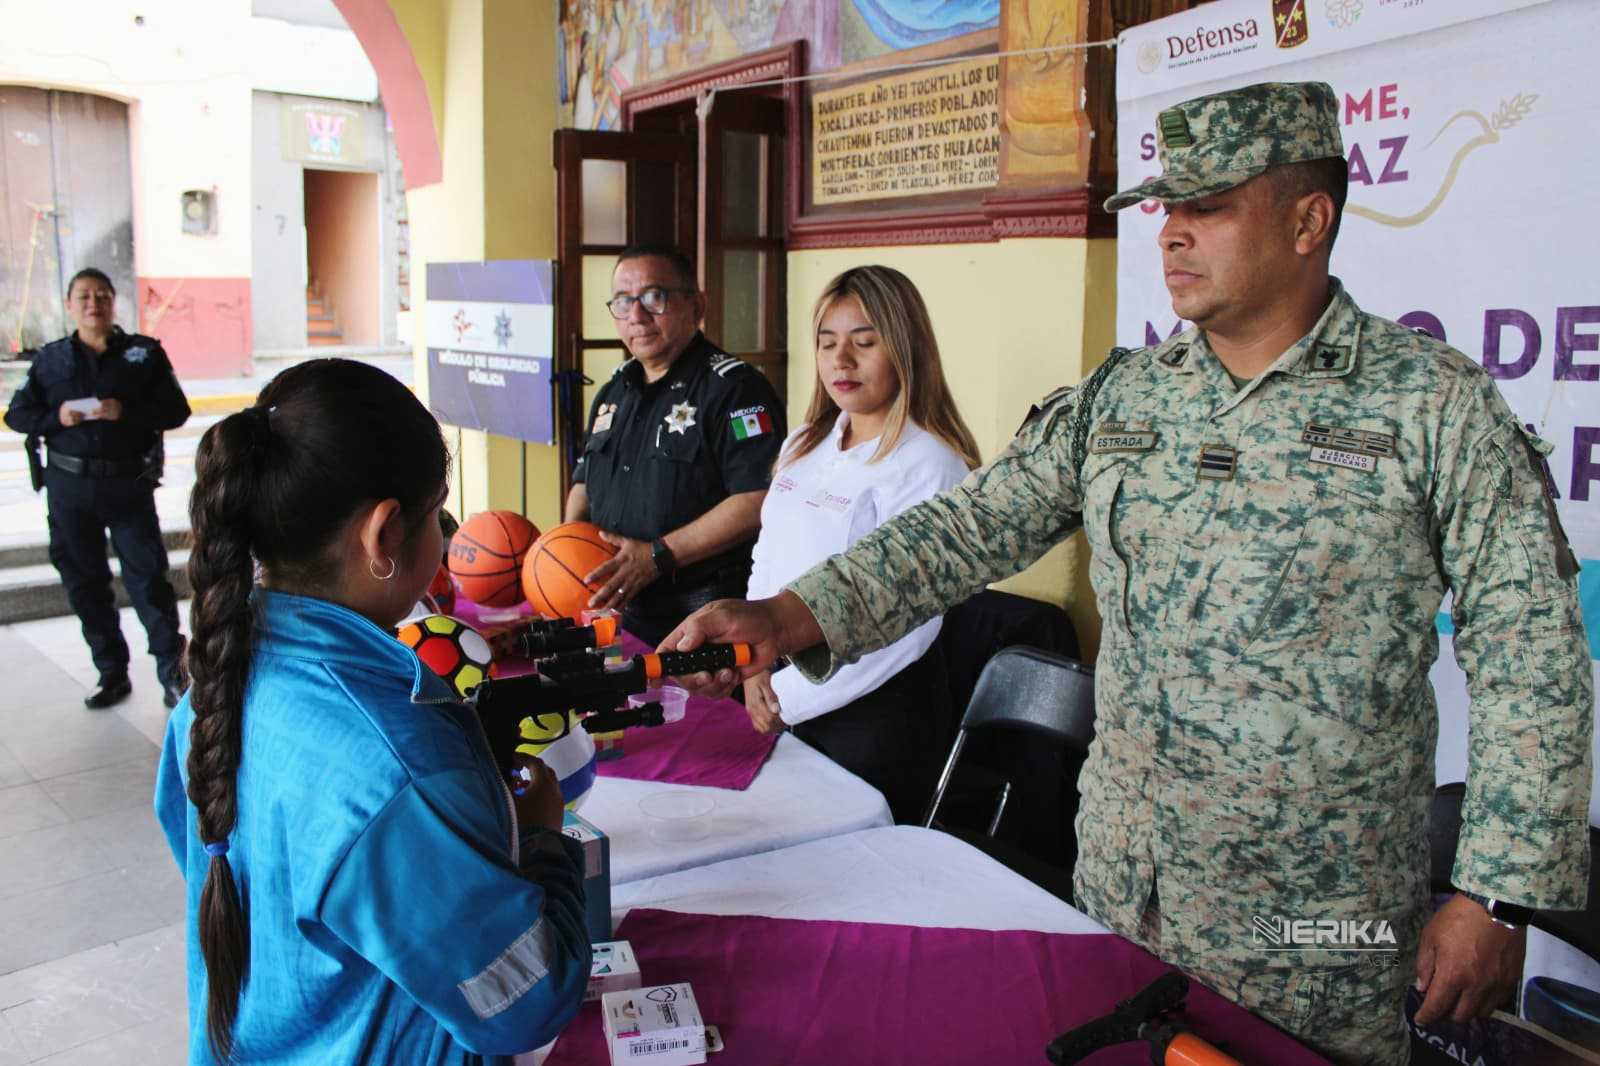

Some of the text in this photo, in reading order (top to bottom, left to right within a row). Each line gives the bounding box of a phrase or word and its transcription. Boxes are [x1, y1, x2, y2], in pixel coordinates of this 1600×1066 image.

[1166, 18, 1258, 59] Defensa
[871, 83, 888, 104] AÑO
[891, 84, 907, 101] YEI
[961, 68, 982, 87] LOS
[887, 99, 938, 121] PRIMEROS
[1344, 83, 1410, 126] ME,
[875, 125, 914, 145] FUERON
[918, 113, 987, 139] DEVASTADOS
[878, 144, 941, 166] CORRIENTES
[1346, 135, 1409, 186] AZ
[1482, 305, 1600, 382] DE
[1096, 437, 1144, 449] ESTRADA
[1319, 454, 1367, 468] MEXICANO
[448, 543, 478, 564] RTS
